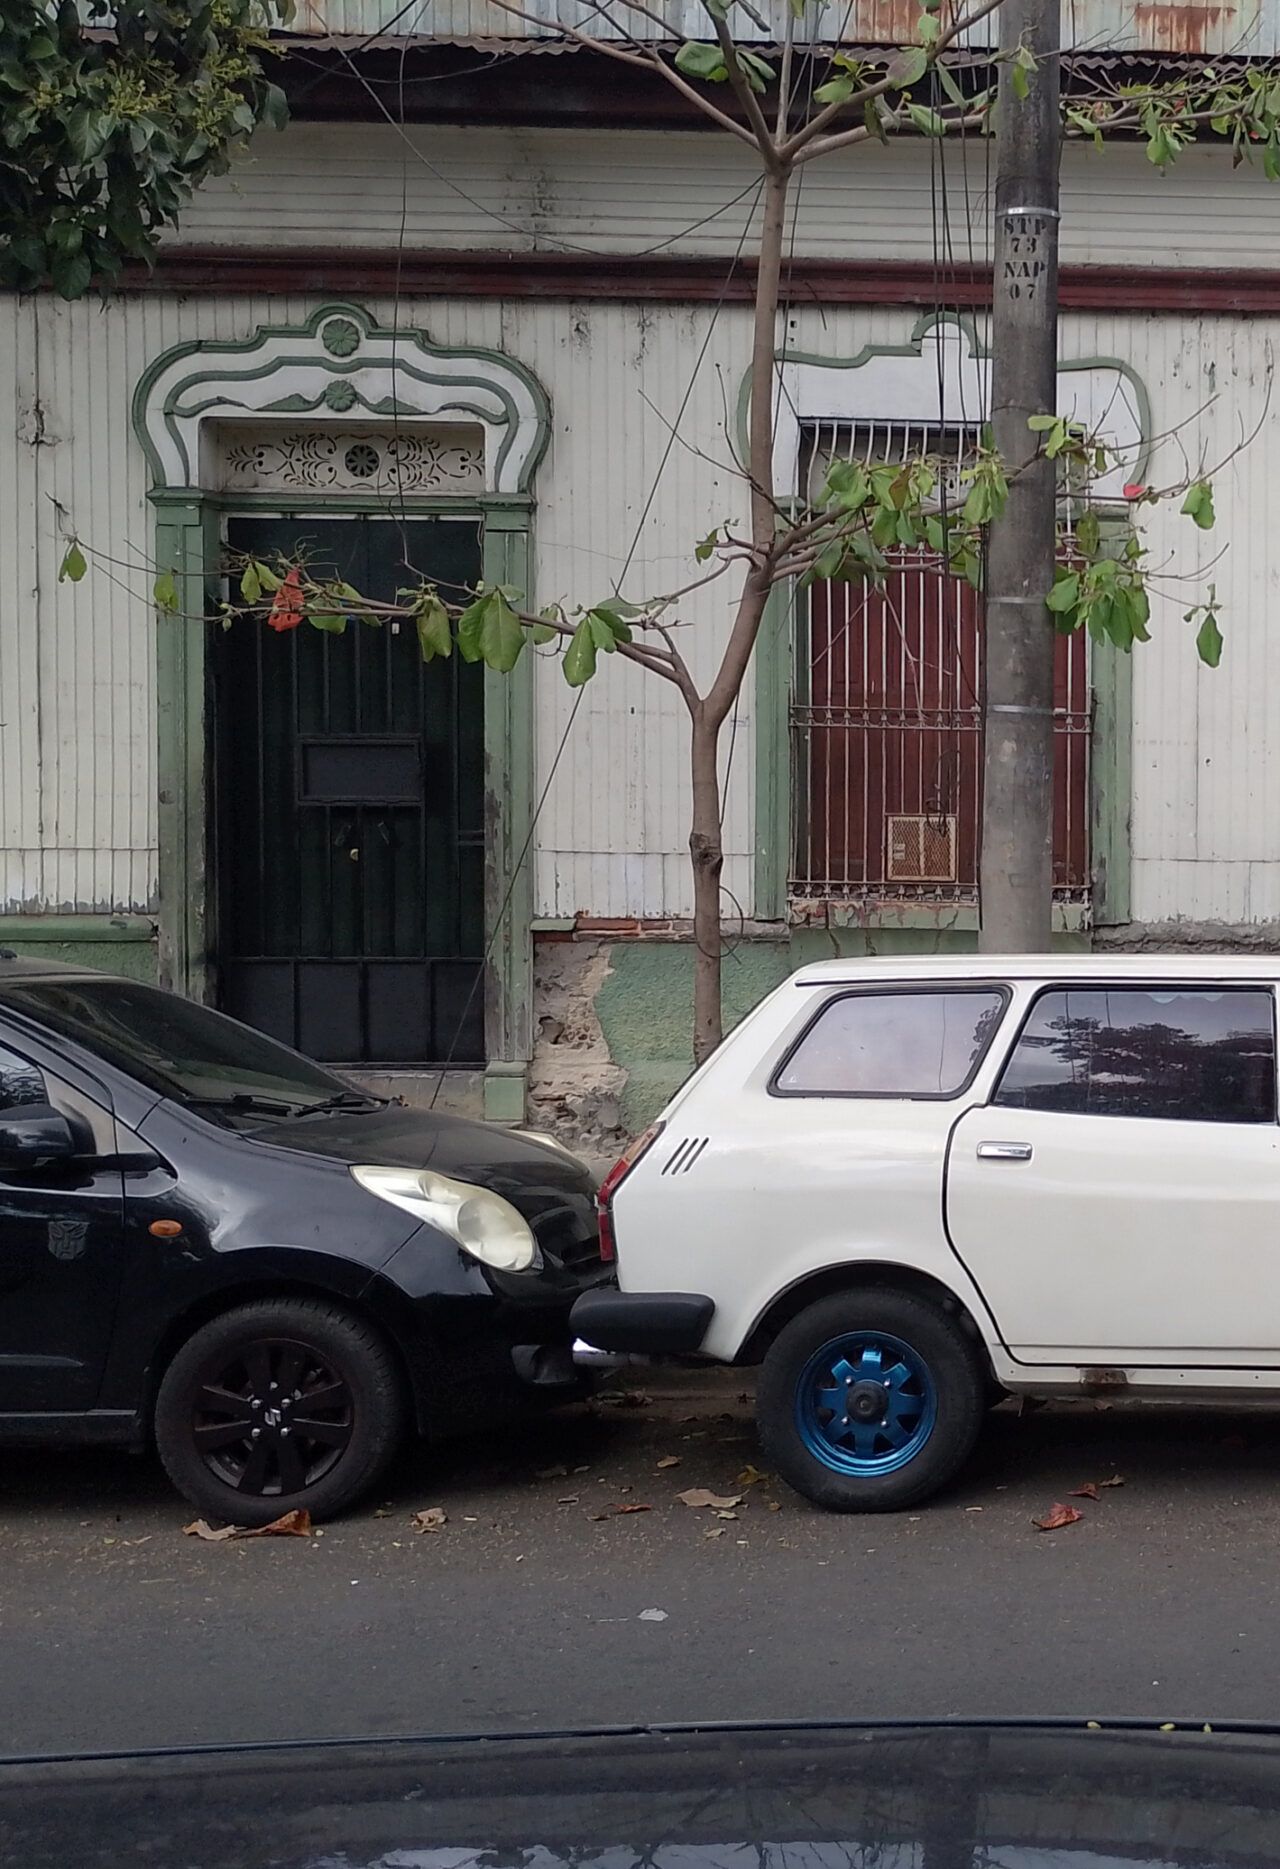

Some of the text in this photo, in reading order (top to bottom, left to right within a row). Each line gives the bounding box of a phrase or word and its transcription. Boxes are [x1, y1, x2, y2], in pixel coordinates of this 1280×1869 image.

[1003, 217, 1047, 235] STP
[1012, 237, 1037, 253] 73
[1004, 261, 1046, 278] NAP
